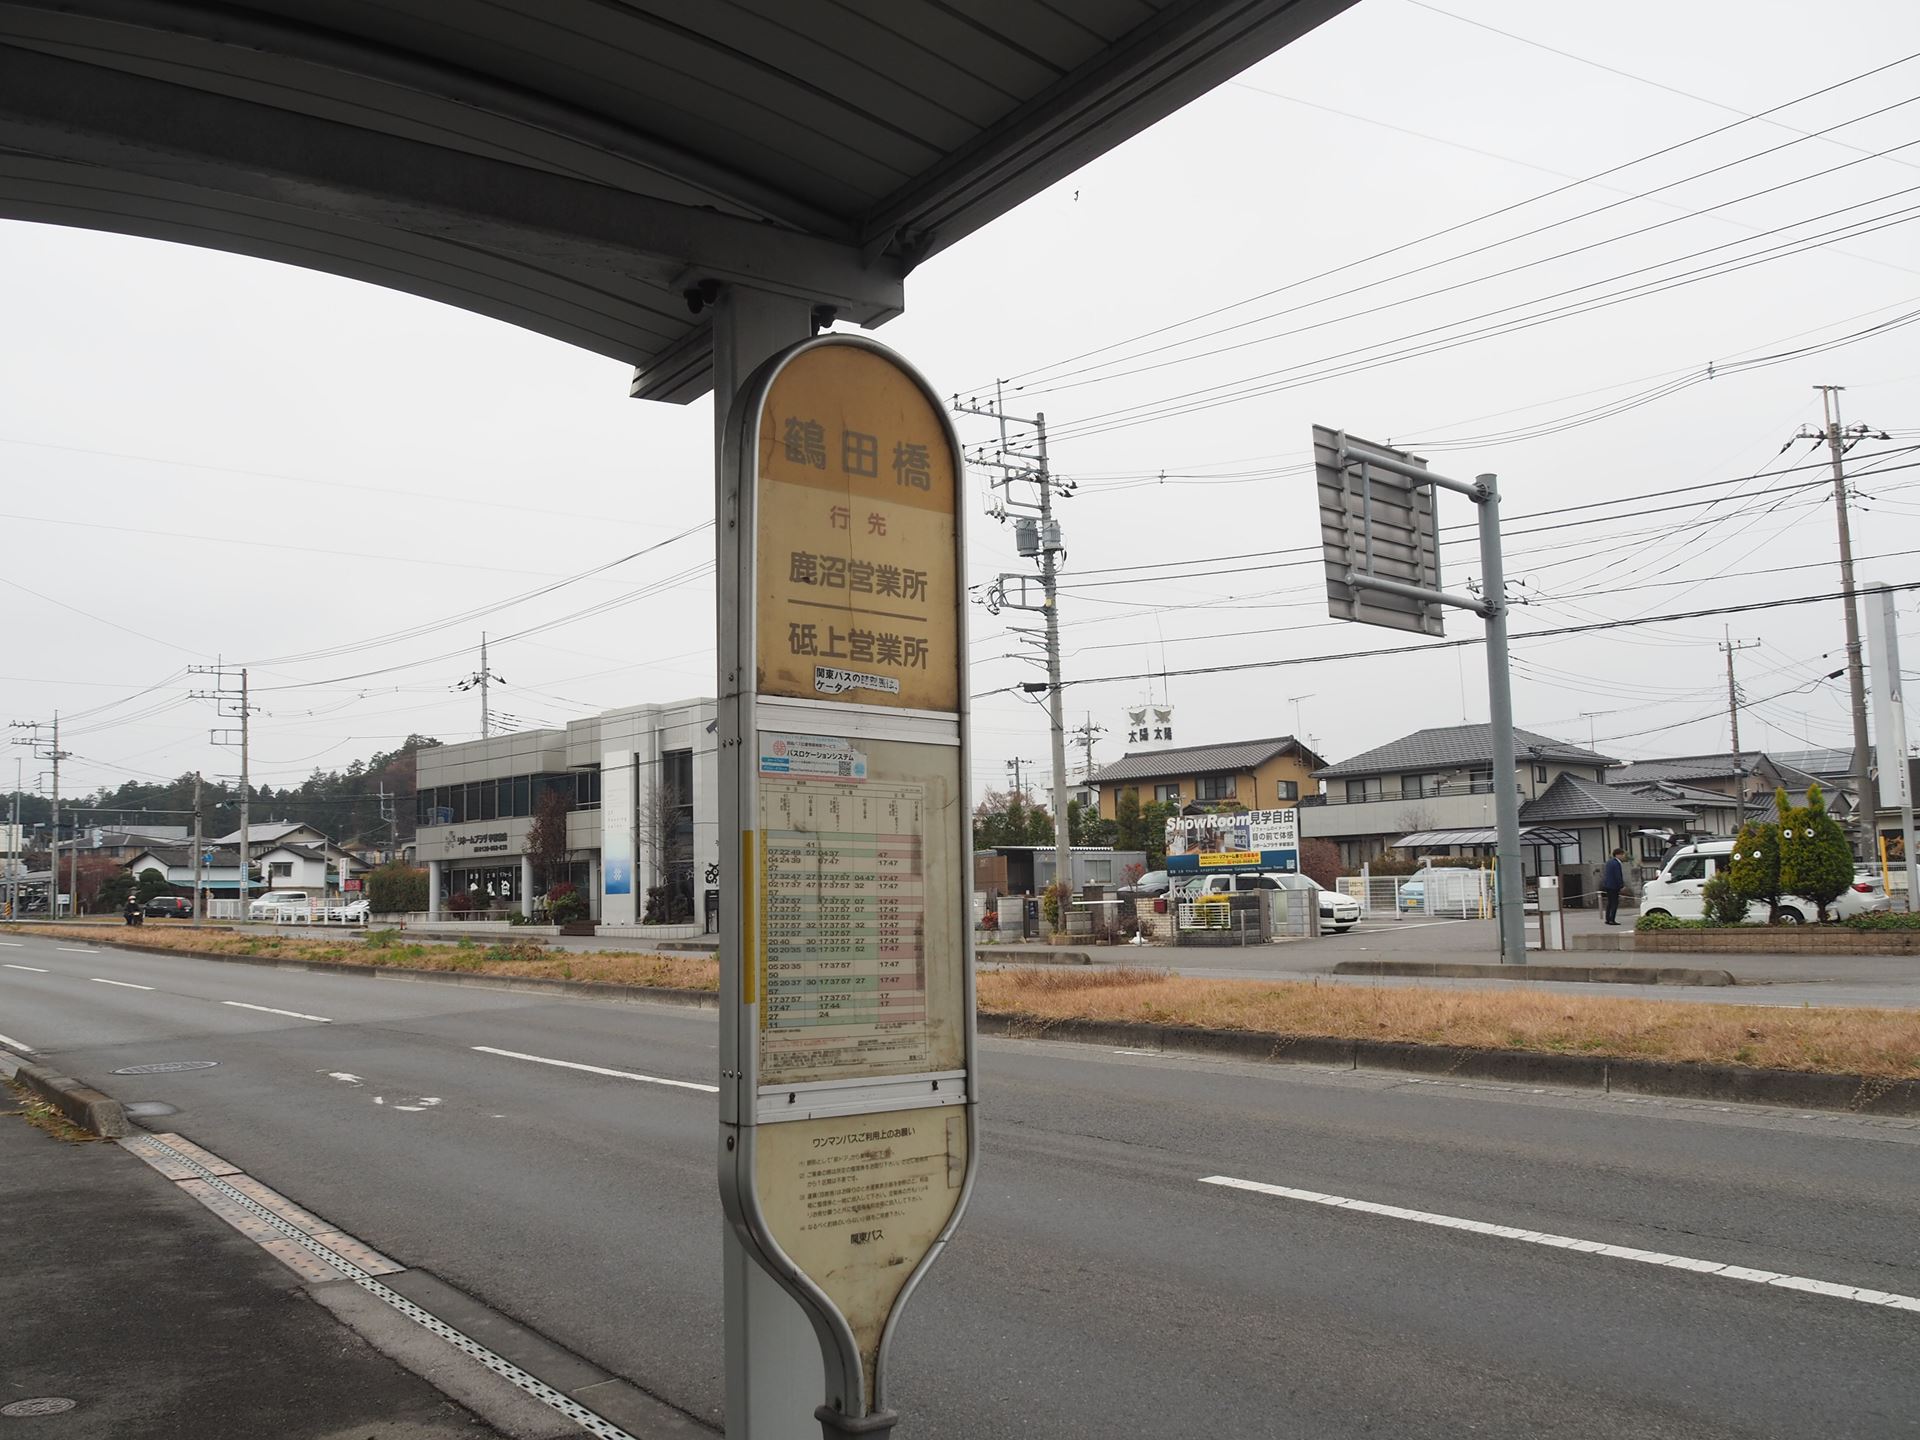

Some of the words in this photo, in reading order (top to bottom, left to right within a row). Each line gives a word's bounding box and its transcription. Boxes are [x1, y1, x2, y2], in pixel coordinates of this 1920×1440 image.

[783, 416, 931, 491] 鶴田橋
[829, 505, 887, 536] 行先
[789, 550, 928, 602] 鹿沼営業所
[788, 622, 929, 670] 砥上営業所
[1128, 727, 1148, 743] 太陽
[1154, 726, 1172, 740] 太陽
[786, 749, 854, 761] バスロケーションシステム
[1166, 814, 1250, 830] ShowRoom
[1250, 809, 1294, 825] 見学自由
[812, 1127, 916, 1148] ワンマンバスご利用上のお願い
[851, 1229, 884, 1245] 関東バス
